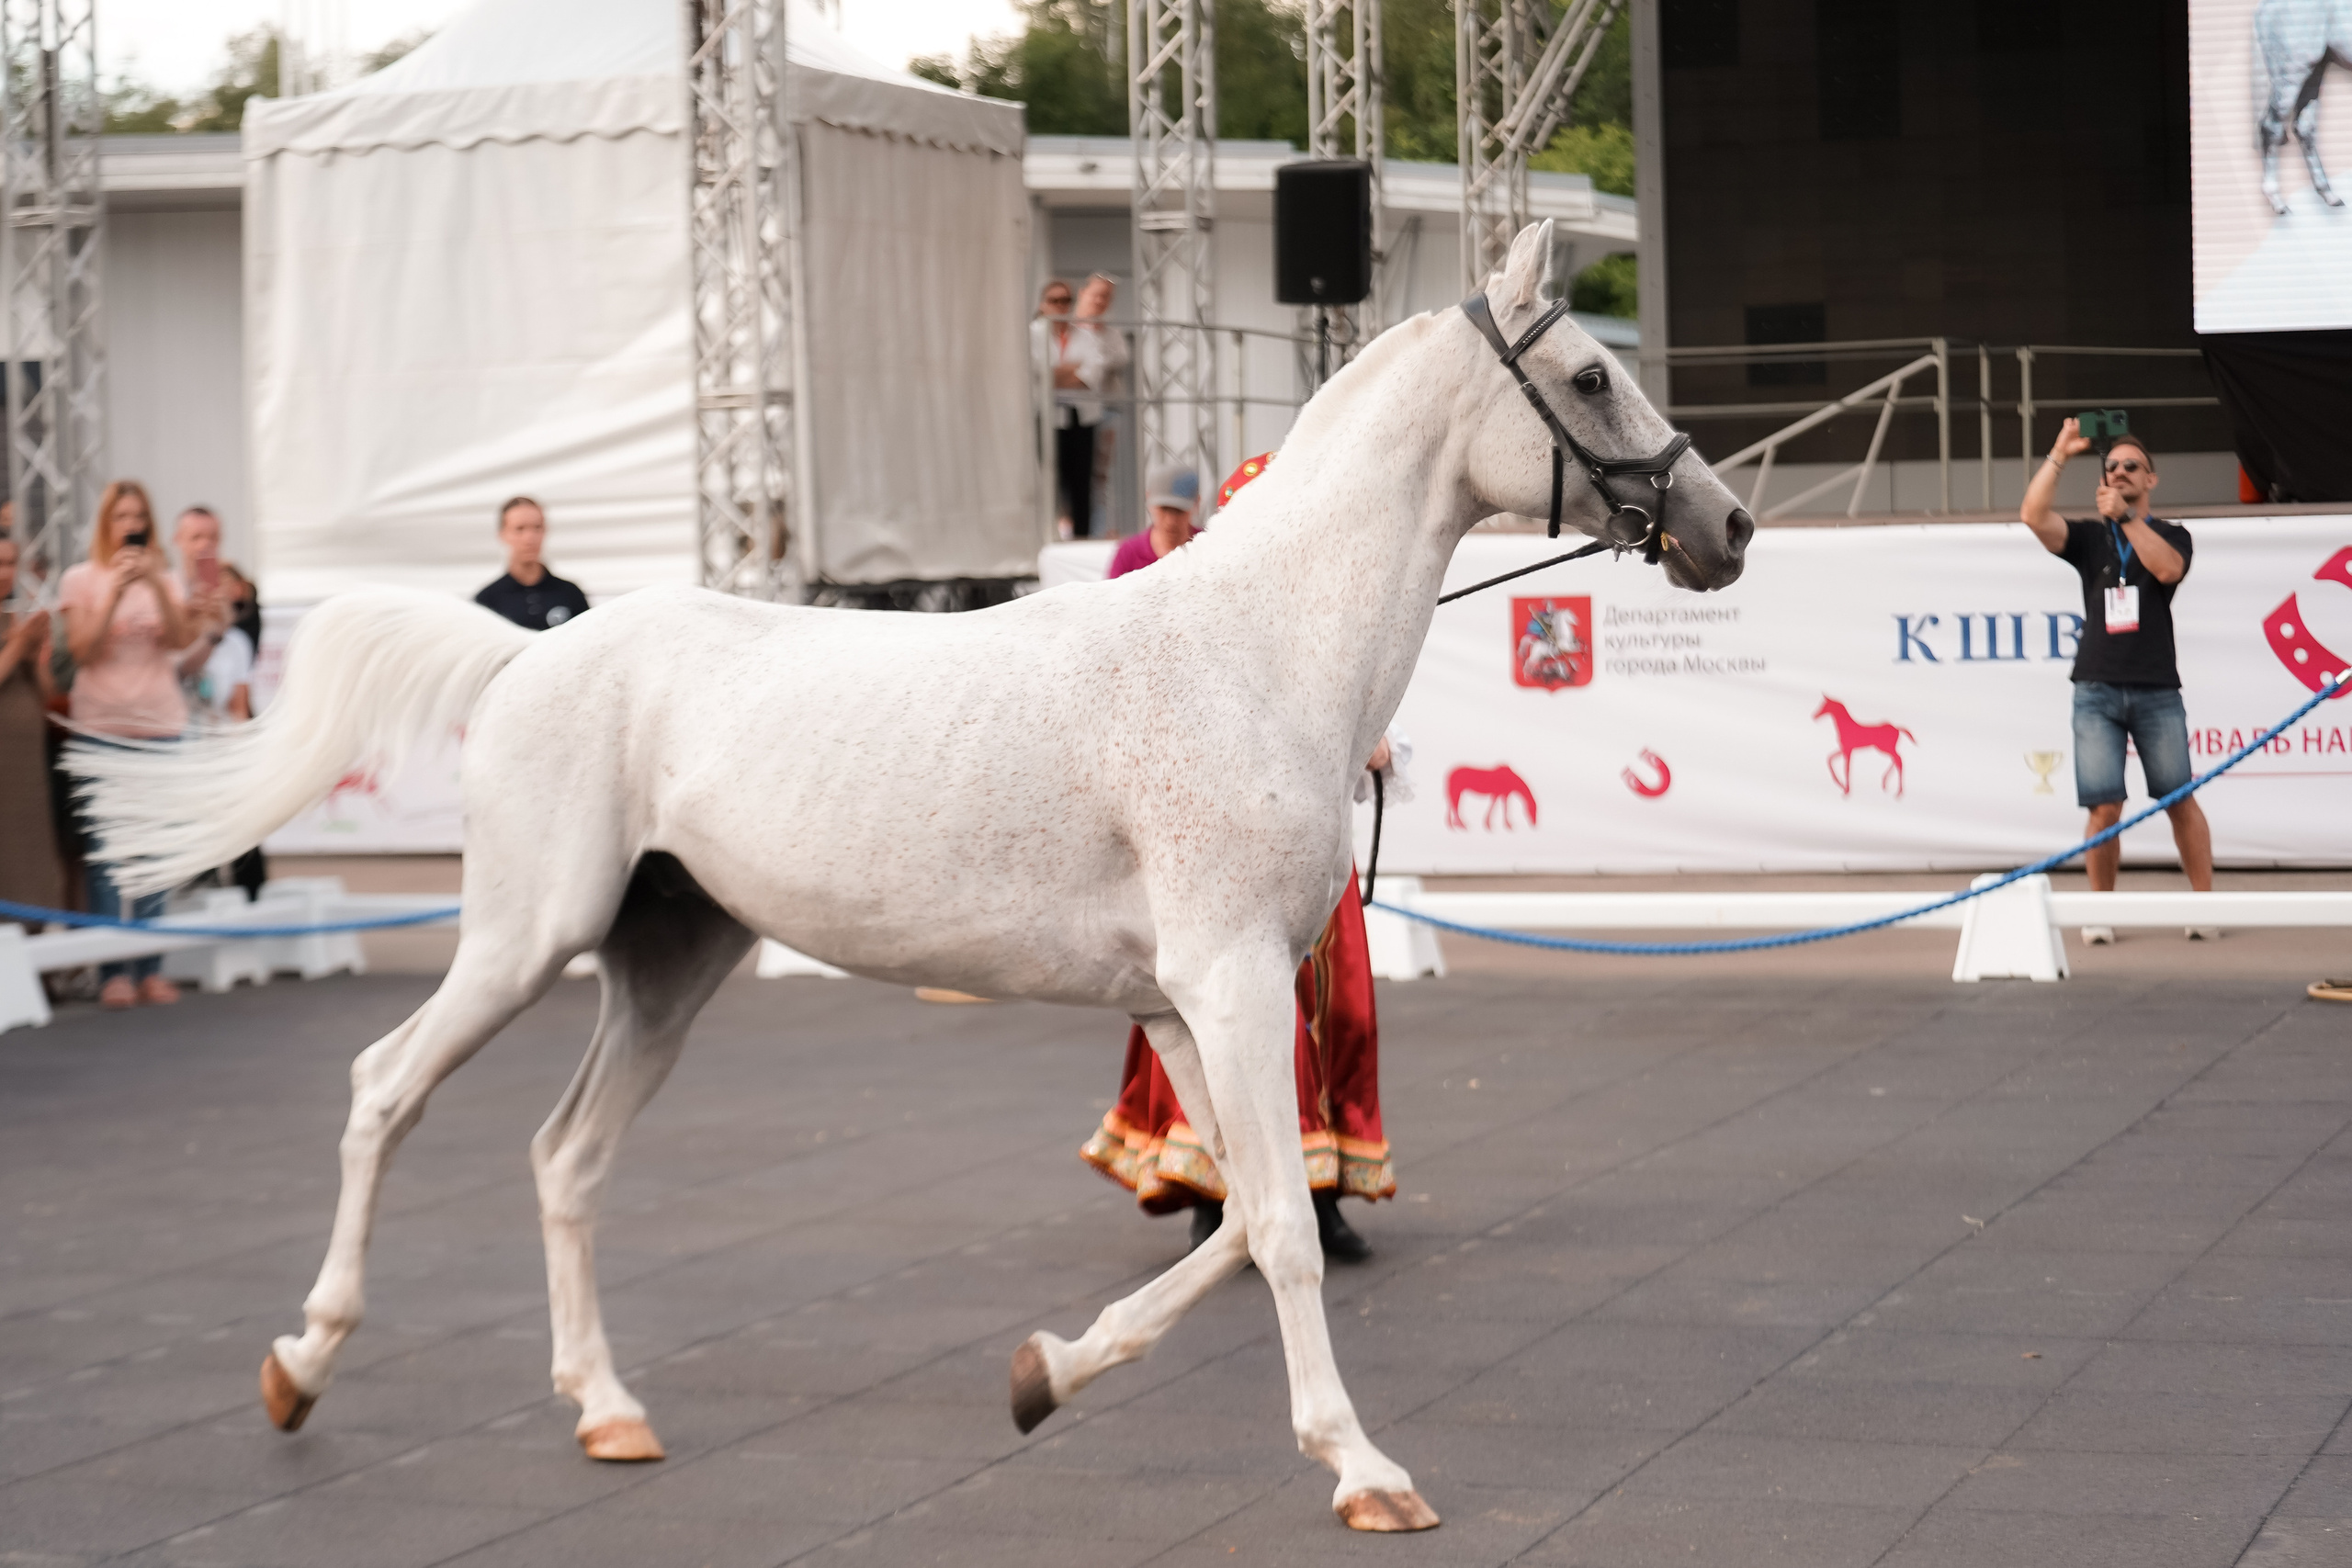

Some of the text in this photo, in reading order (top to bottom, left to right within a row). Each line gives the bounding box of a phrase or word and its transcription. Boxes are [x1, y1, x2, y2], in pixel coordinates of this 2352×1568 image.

[1603, 604, 1741, 626] Департамент
[1604, 632, 1702, 653] культуры
[1605, 653, 1767, 678] города Москвы
[2301, 726, 2352, 754] НА
